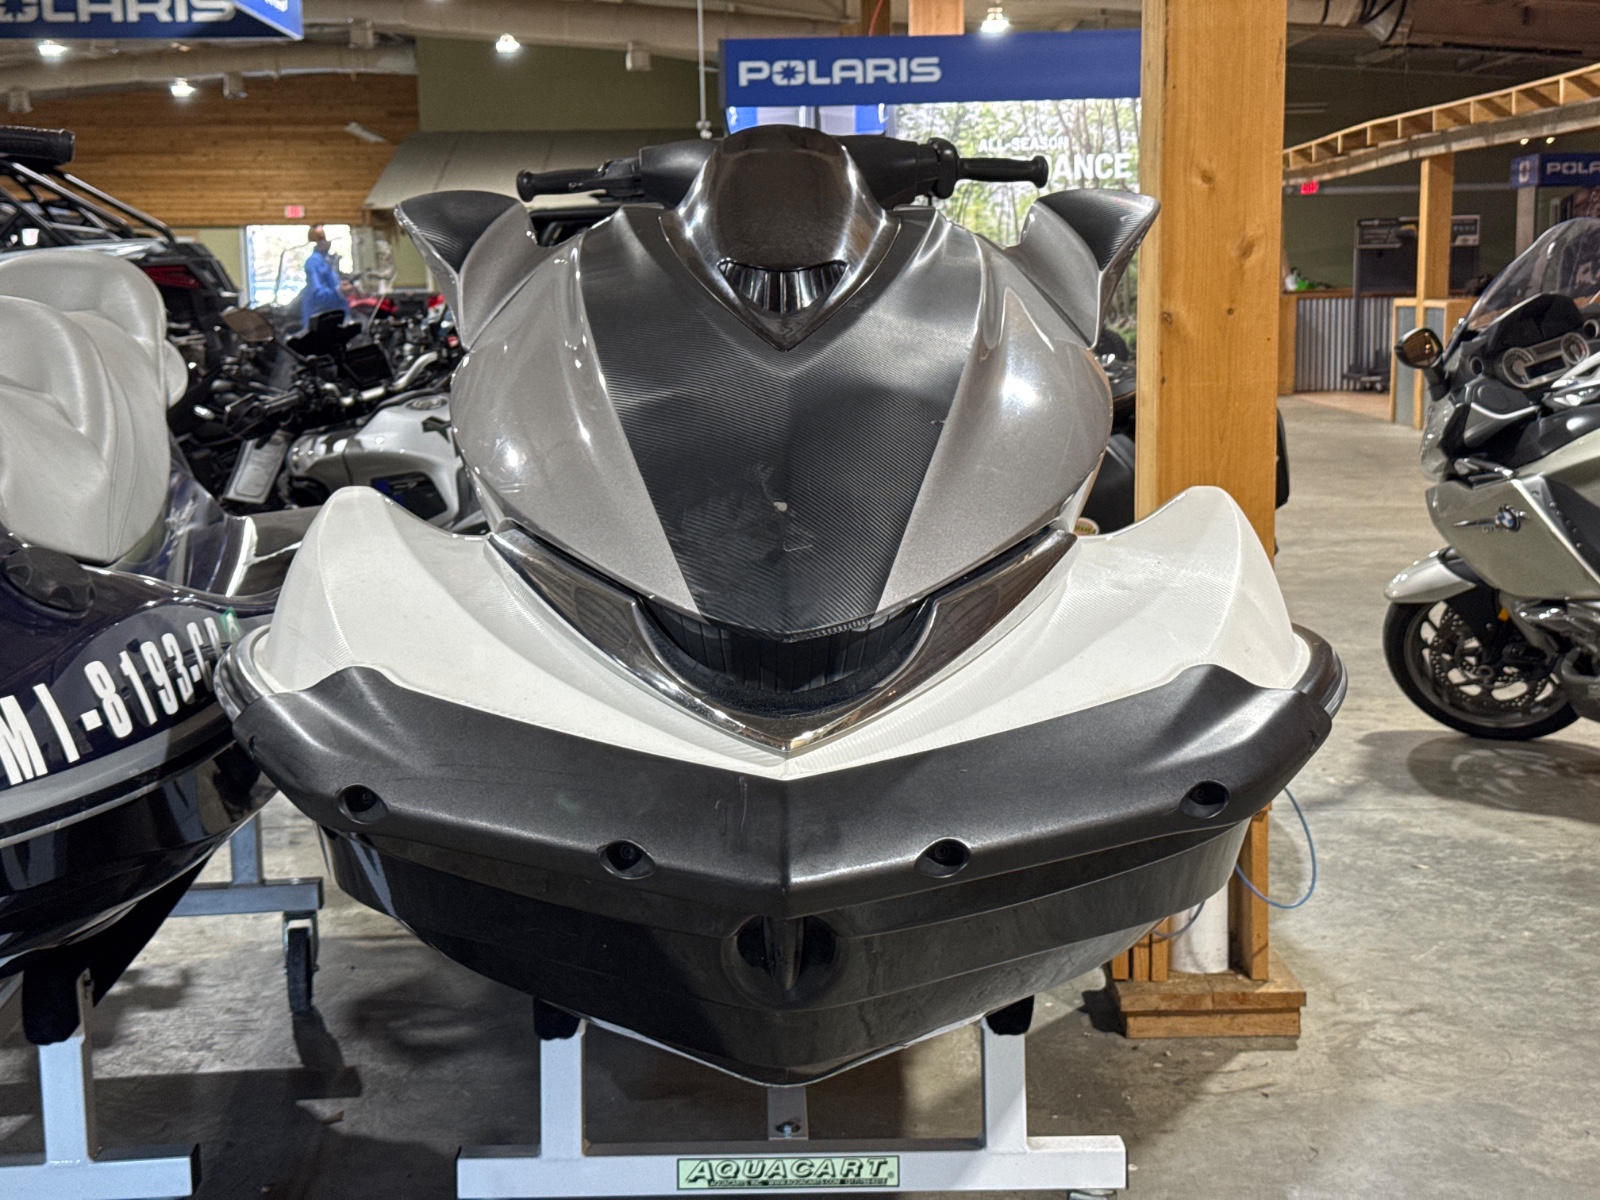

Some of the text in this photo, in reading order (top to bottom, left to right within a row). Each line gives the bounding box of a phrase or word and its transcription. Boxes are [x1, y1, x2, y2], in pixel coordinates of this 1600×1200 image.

[738, 56, 942, 87] POLARIS
[978, 135, 1069, 152] ALL-SEASON
[1050, 152, 1133, 180] ANCE
[686, 1157, 888, 1182] AQUACART
